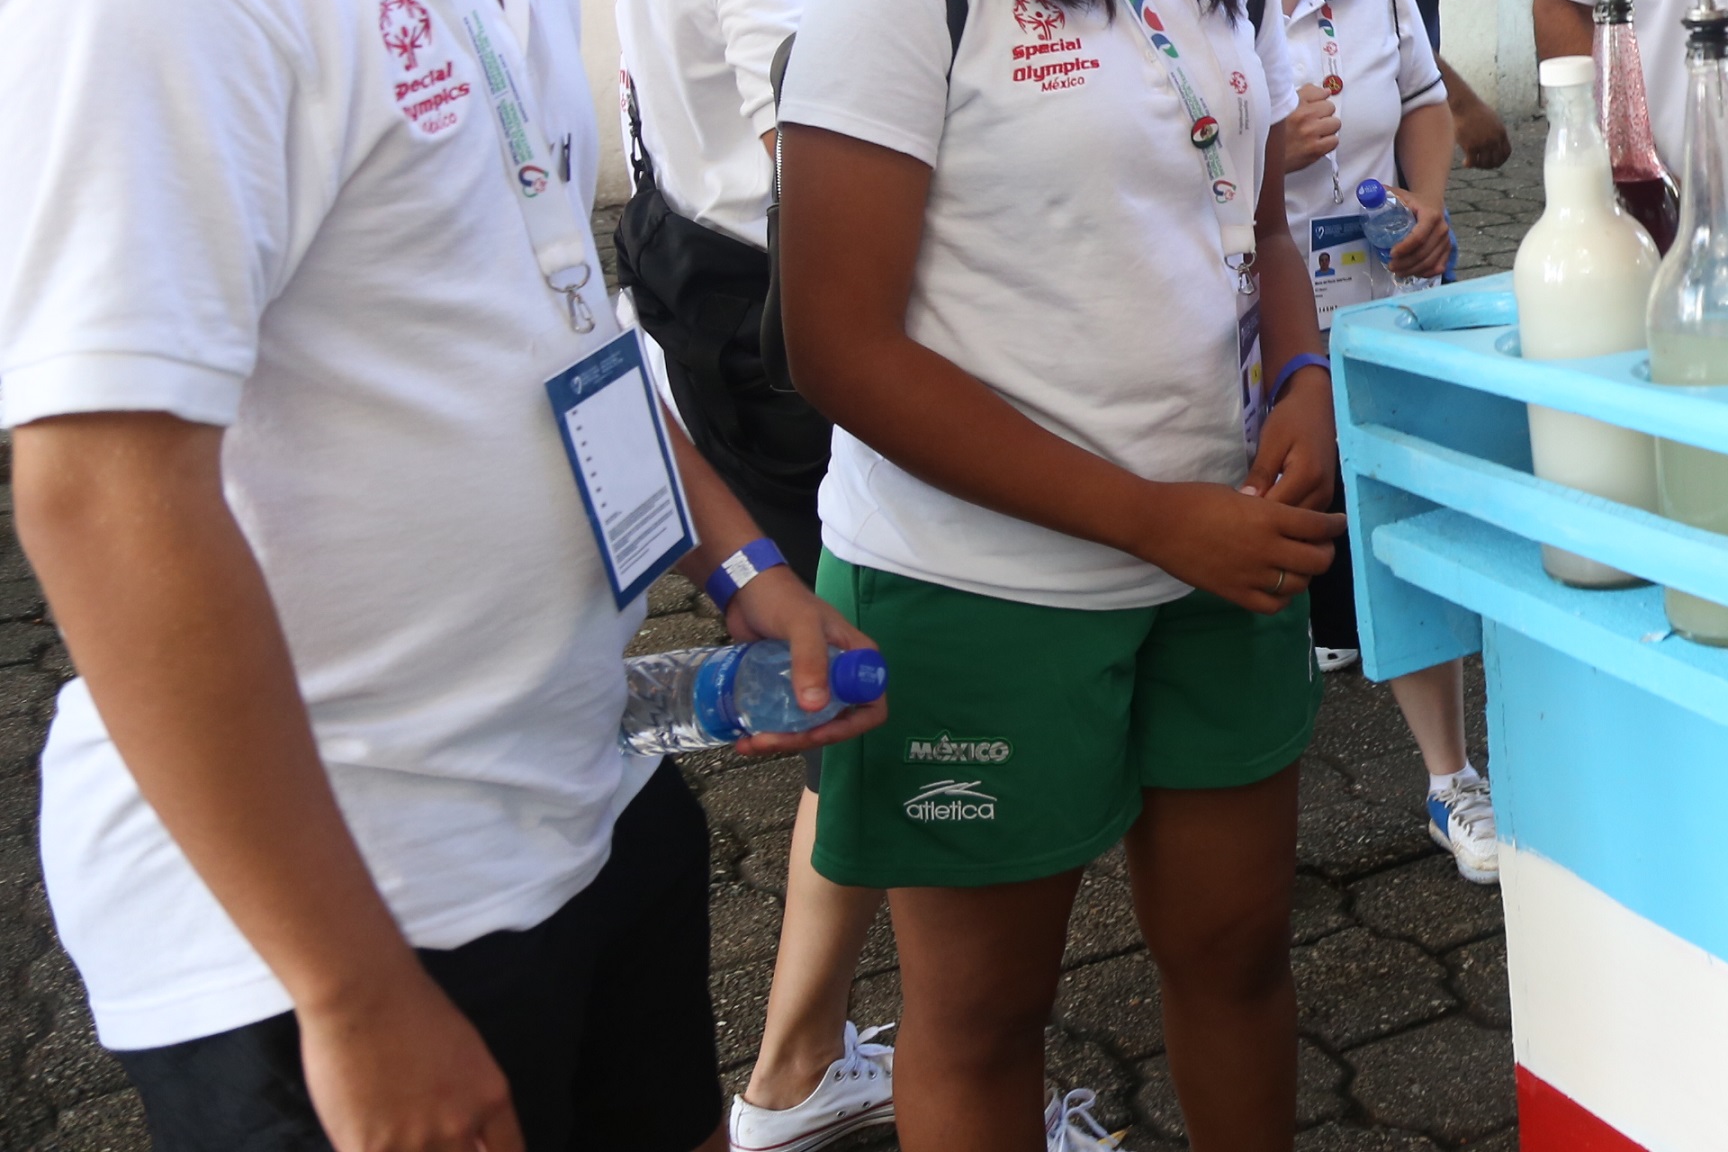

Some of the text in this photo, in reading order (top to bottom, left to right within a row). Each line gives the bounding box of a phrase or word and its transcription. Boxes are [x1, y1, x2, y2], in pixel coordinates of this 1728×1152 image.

[1011, 38, 1082, 61] Special
[1012, 58, 1101, 83] Olympics
[1041, 76, 1085, 92] México
